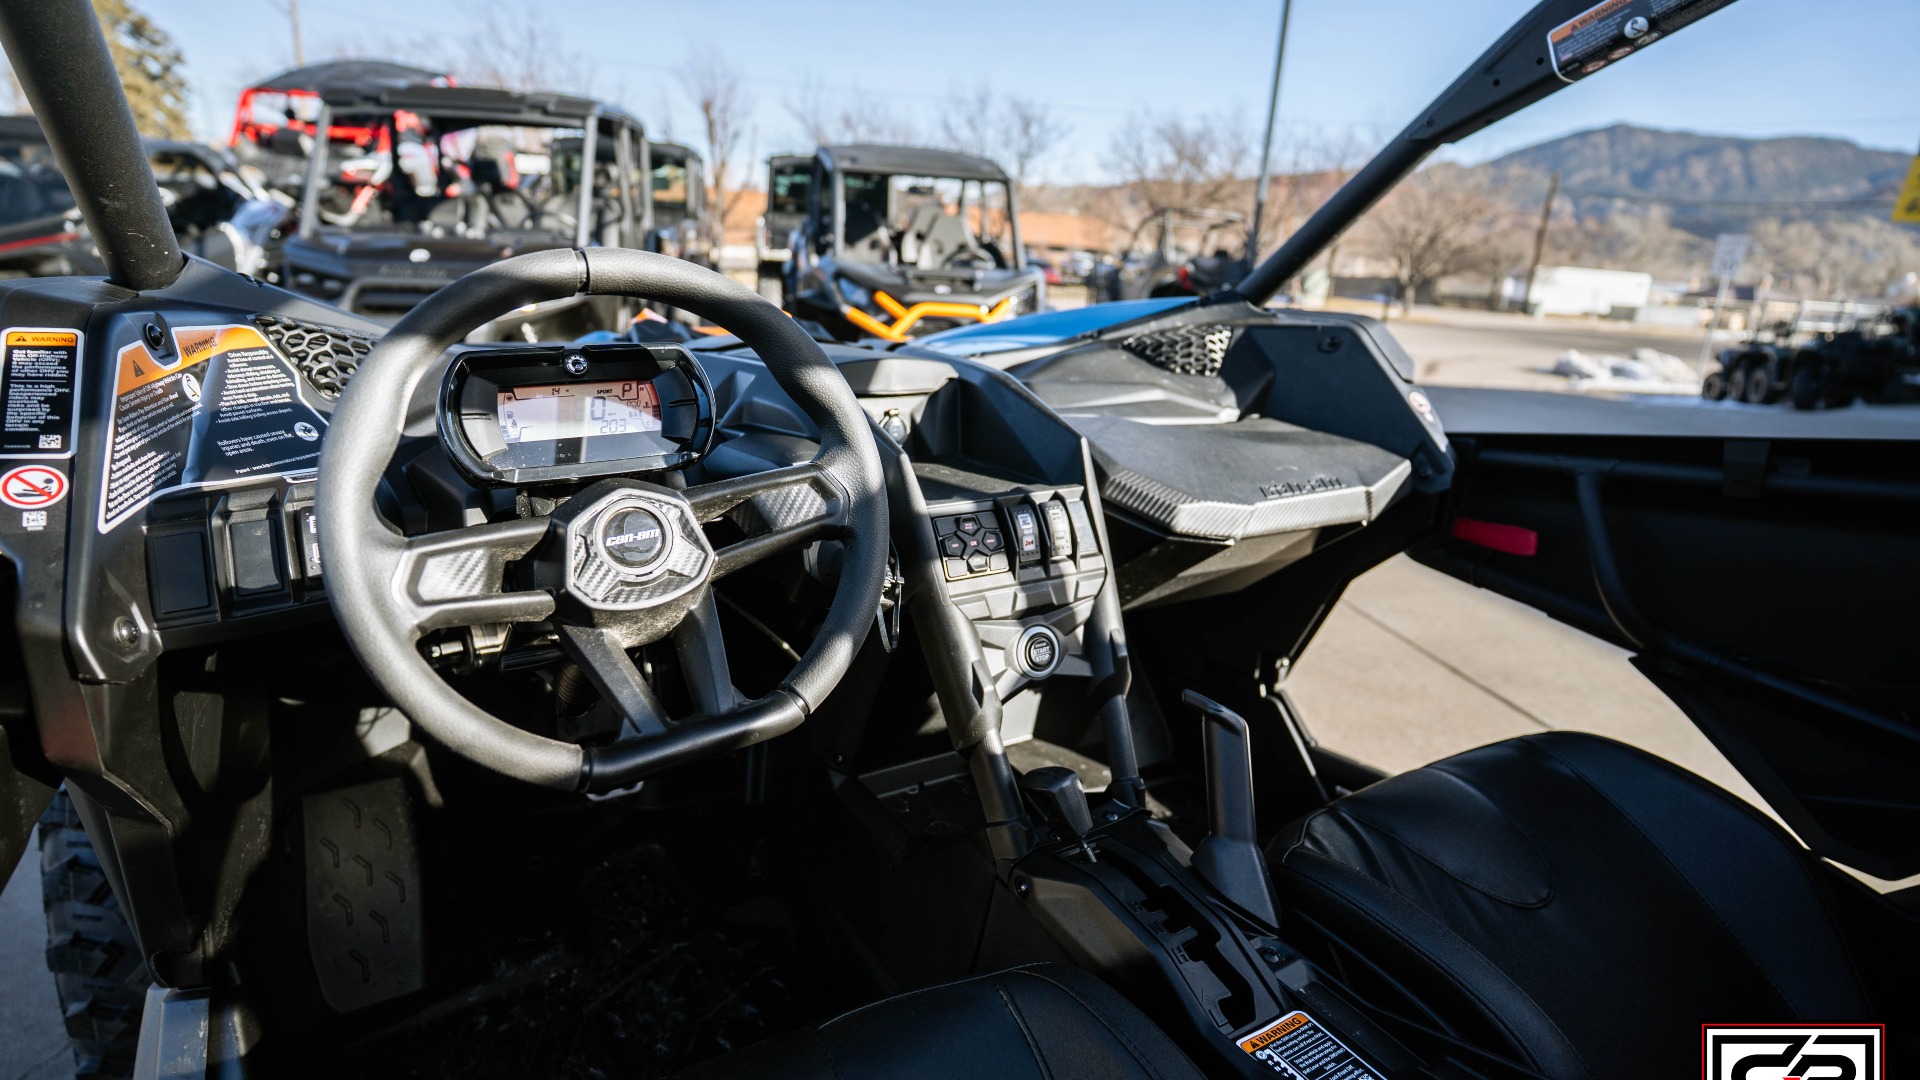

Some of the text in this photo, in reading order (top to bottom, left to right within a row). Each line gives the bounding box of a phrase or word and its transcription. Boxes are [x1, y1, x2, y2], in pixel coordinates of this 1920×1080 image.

[183, 337, 217, 357] WARNING
[622, 383, 632, 397] P
[591, 396, 606, 420] 0
[600, 418, 626, 433] 203
[606, 528, 660, 546] can-am
[1034, 646, 1050, 654] START
[1035, 654, 1050, 662] STOP
[1257, 1017, 1302, 1044] WARNING
